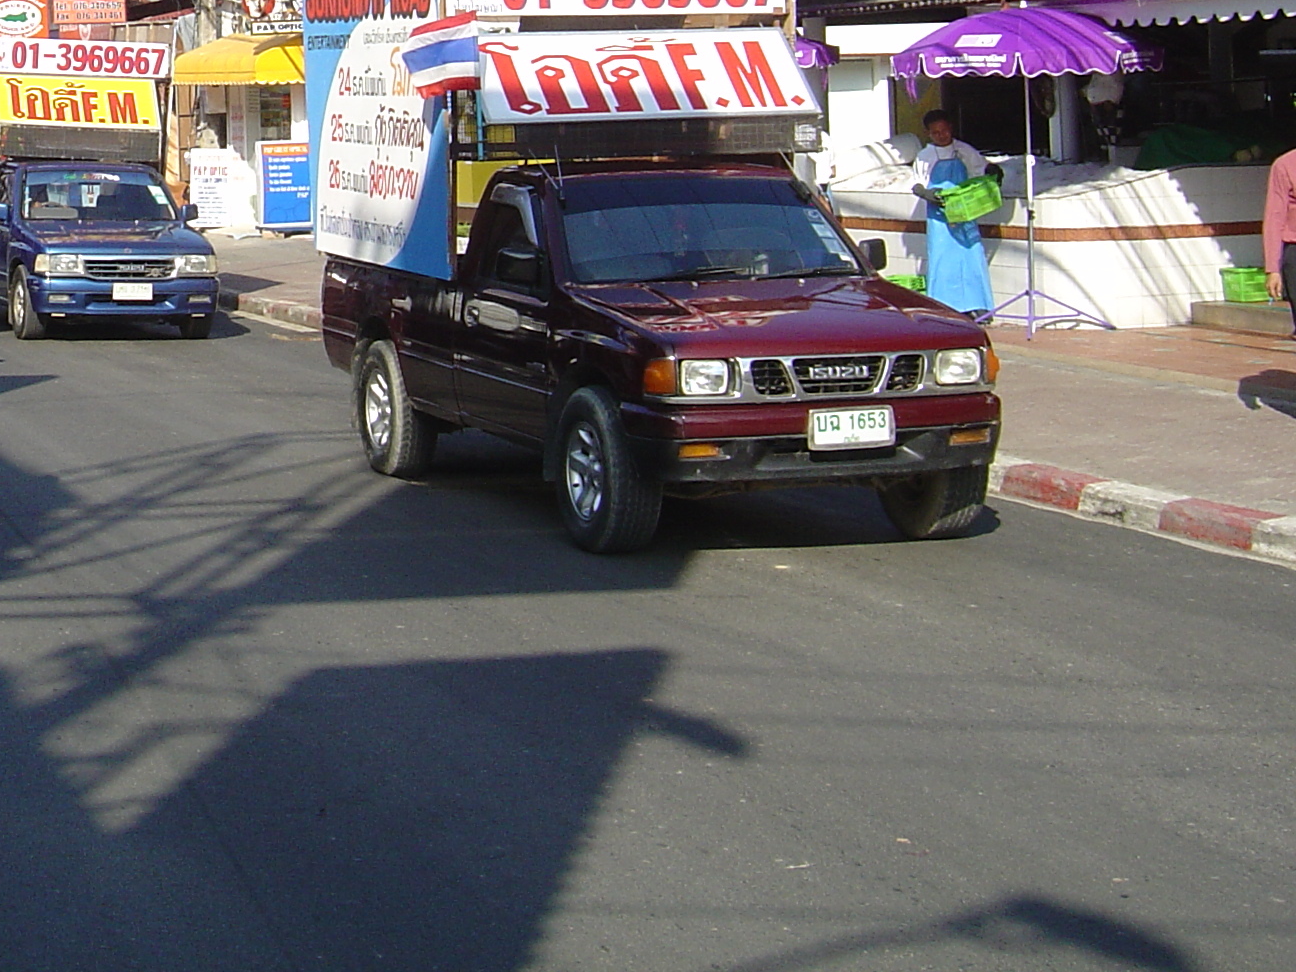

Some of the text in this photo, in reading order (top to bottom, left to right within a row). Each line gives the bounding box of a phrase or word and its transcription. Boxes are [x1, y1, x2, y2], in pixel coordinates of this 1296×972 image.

[11, 40, 166, 75] 01-3969667
[338, 66, 352, 97] 24
[330, 113, 344, 142] 25
[328, 159, 341, 189] 26
[808, 365, 869, 380] ISUZU
[849, 410, 887, 430] 1653
